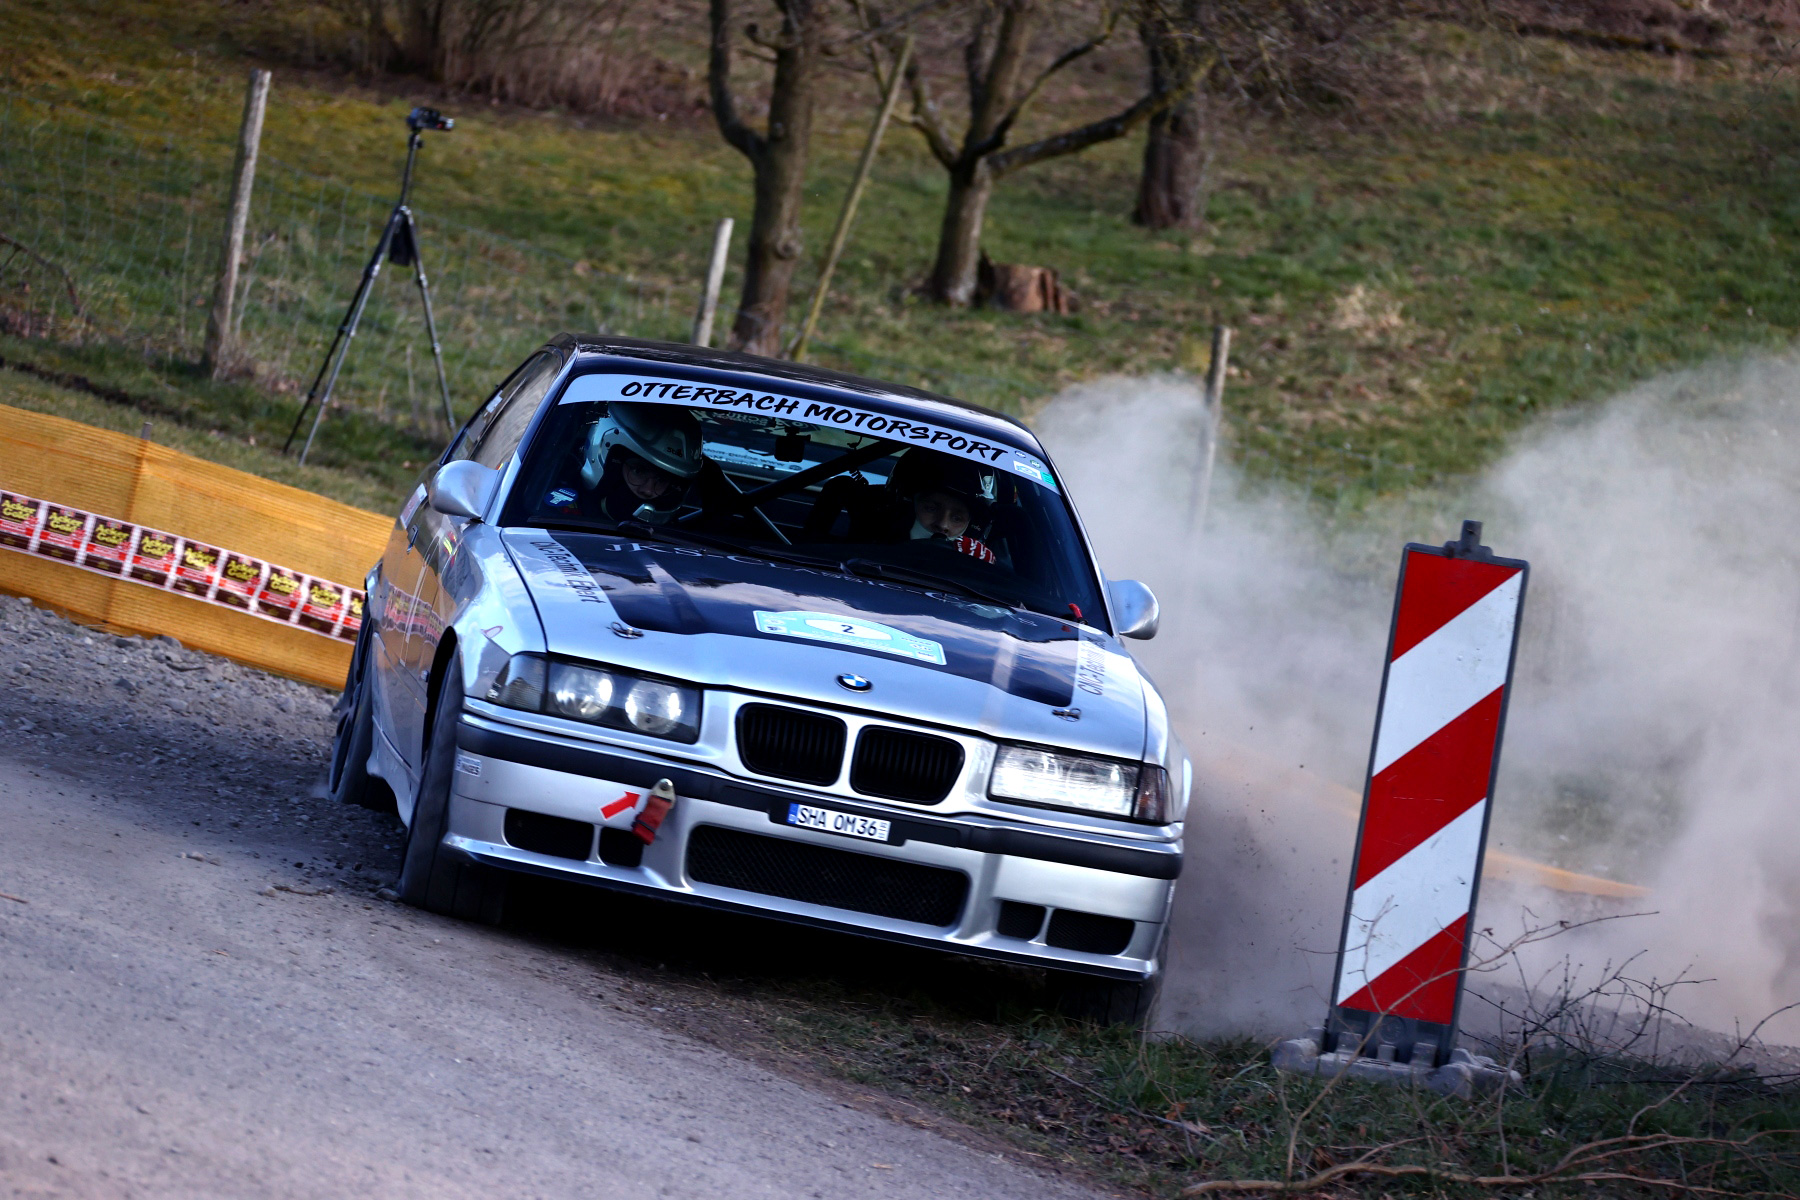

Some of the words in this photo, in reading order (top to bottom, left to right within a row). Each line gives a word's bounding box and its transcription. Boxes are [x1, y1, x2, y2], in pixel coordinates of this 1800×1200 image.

[620, 381, 800, 415] OTTERBACH
[808, 402, 1008, 462] MOTORSPORT
[1, 499, 36, 514] Acker
[48, 511, 84, 526] Acker
[95, 523, 129, 539] Acker
[566, 578, 608, 604] Ebert
[840, 624, 856, 635] 2
[797, 807, 827, 828] SHA
